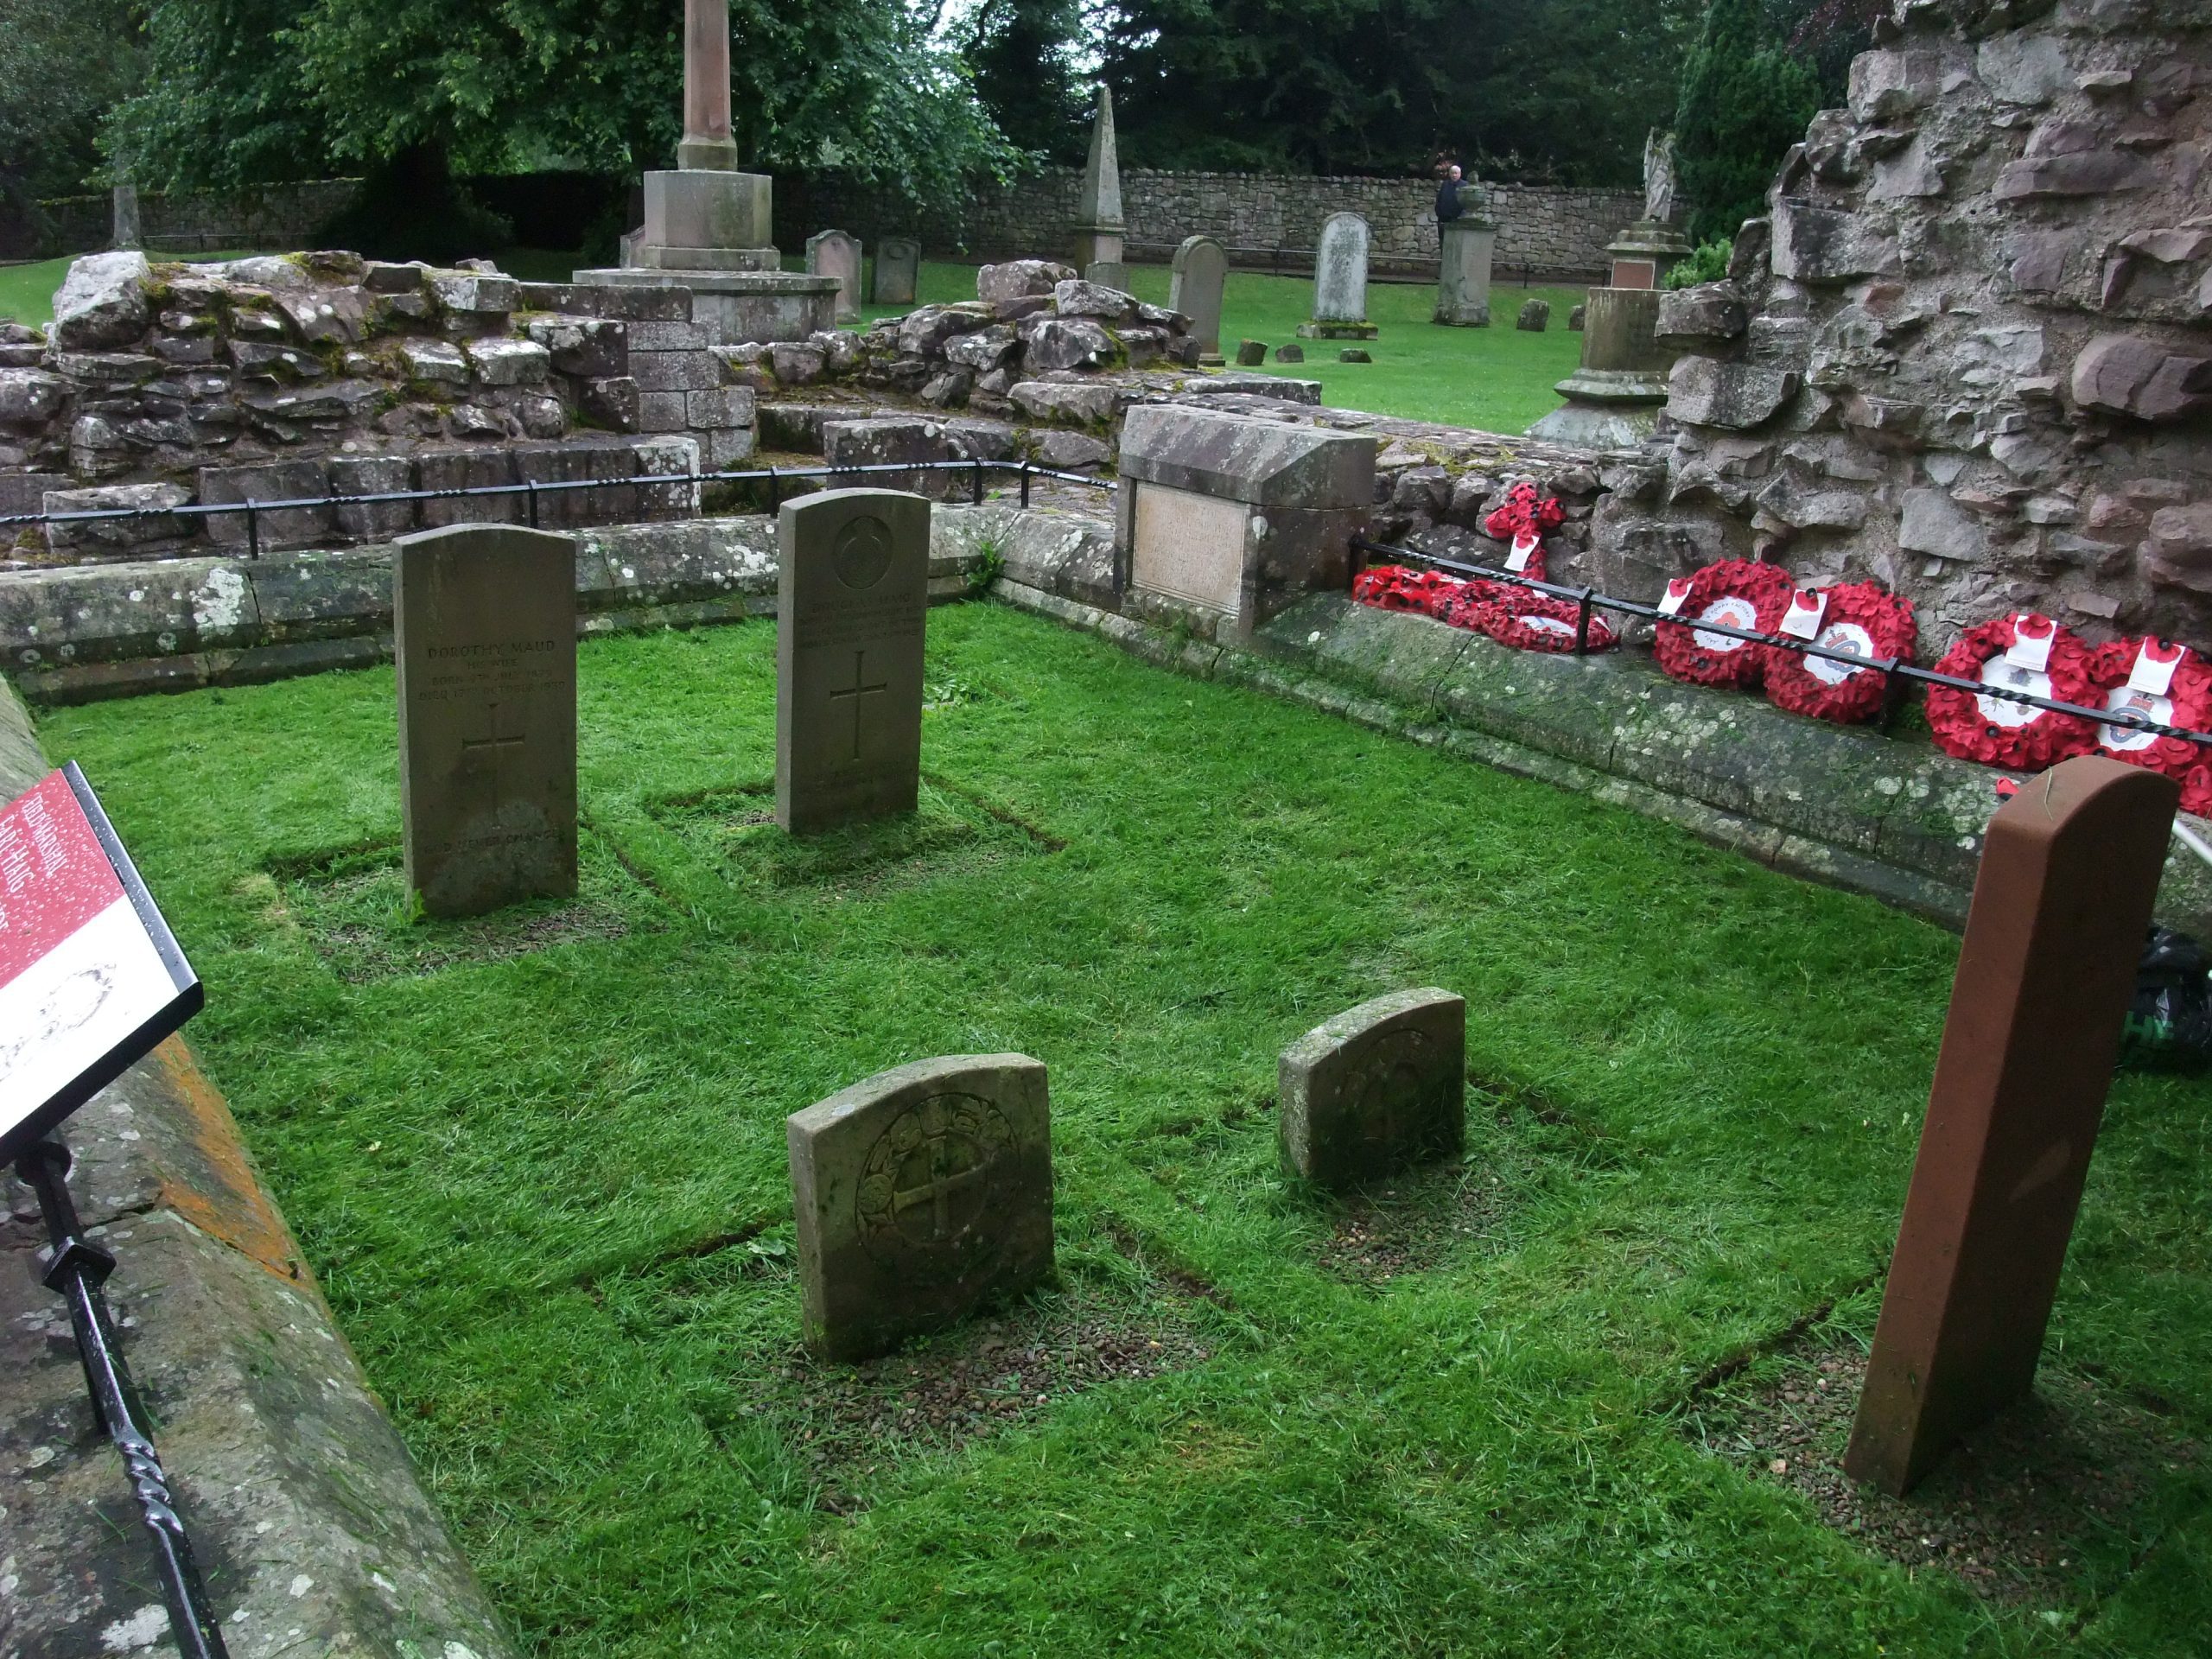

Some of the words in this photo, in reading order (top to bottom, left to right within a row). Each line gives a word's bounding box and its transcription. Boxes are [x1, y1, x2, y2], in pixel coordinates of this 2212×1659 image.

[428, 643, 505, 659] DOROTHY
[511, 640, 556, 653] MAUD
[431, 675, 465, 687] BORN
[417, 689, 449, 702] DIED
[31, 817, 68, 875] MARSHAL
[1, 843, 35, 893] HAIG
